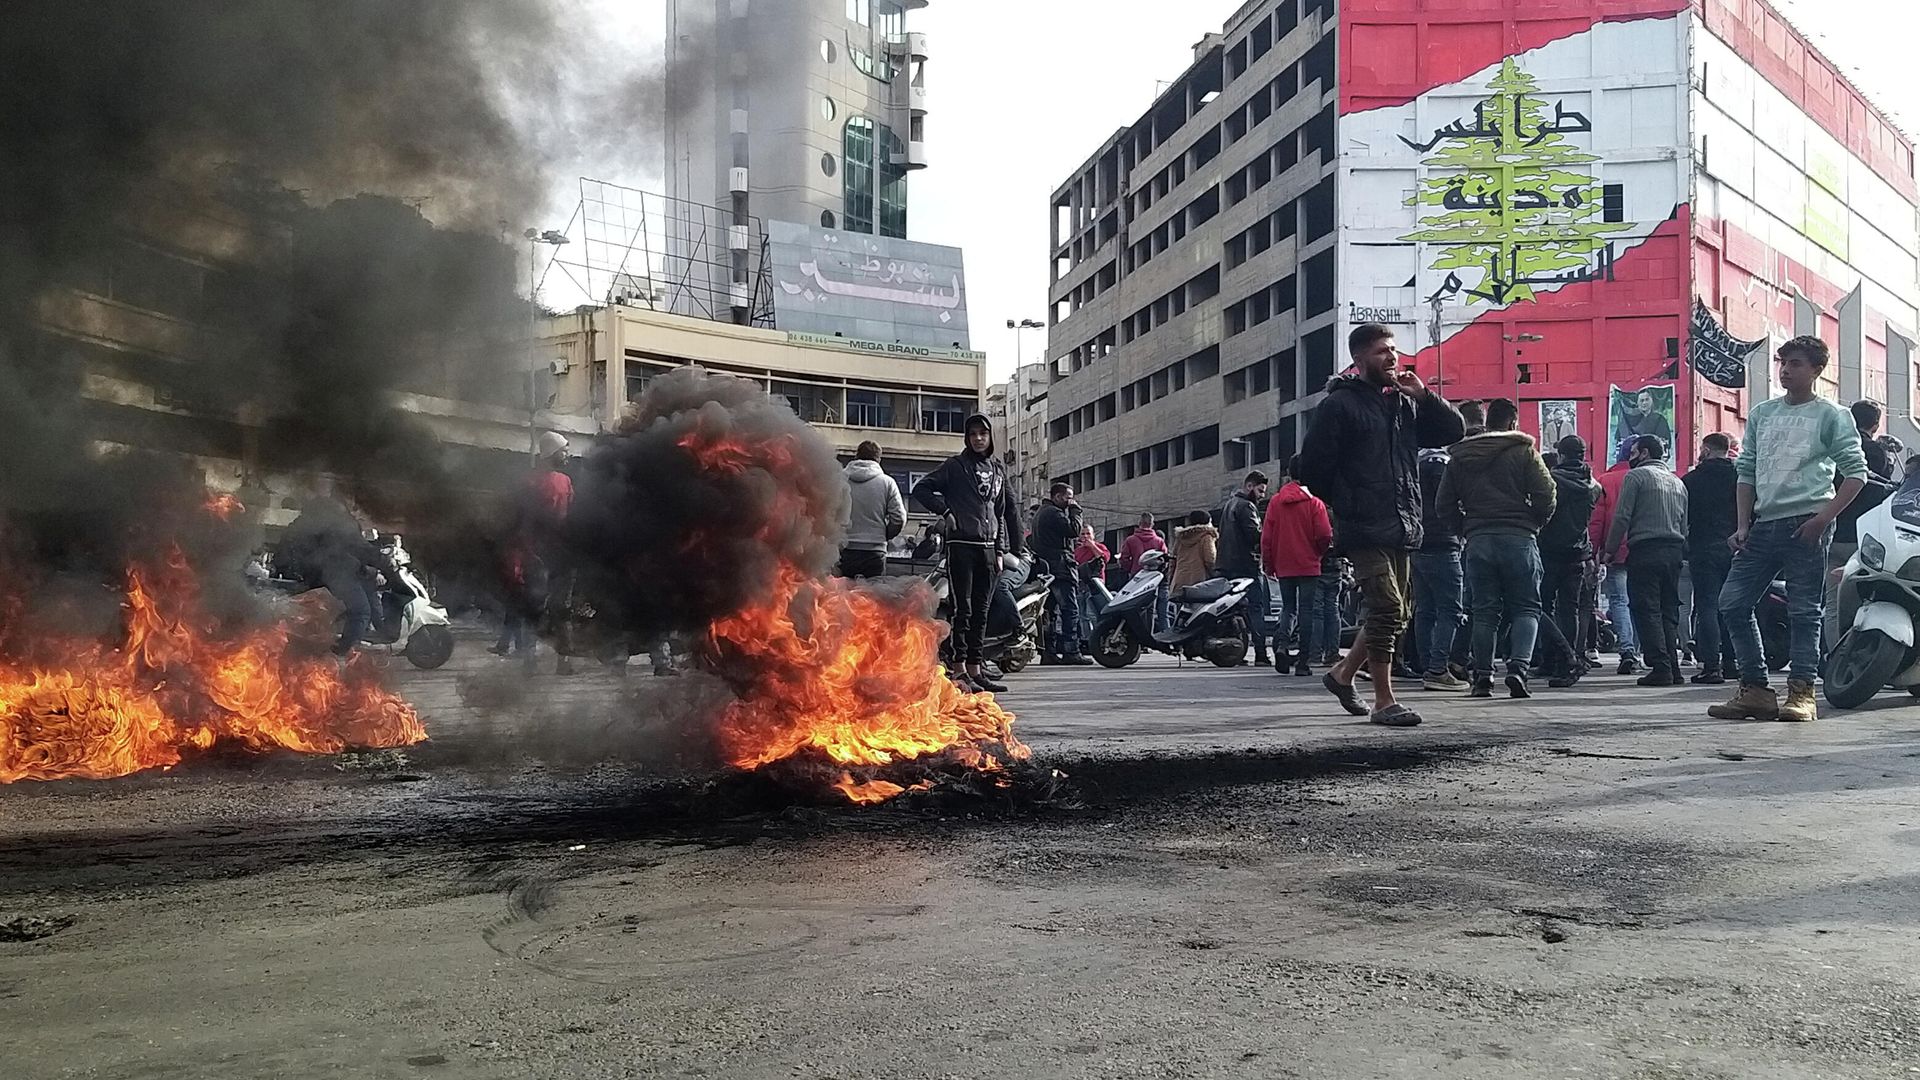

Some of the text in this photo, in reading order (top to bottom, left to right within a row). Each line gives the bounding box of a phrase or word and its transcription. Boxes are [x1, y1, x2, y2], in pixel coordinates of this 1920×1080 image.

[1396, 93, 1592, 153] طرابلس
[1443, 178, 1583, 217] مدينة
[1432, 242, 1615, 305] السلام
[1349, 307, 1401, 321] ABRASHH
[849, 340, 884, 351] MEGA
[887, 343, 929, 356] BRAND
